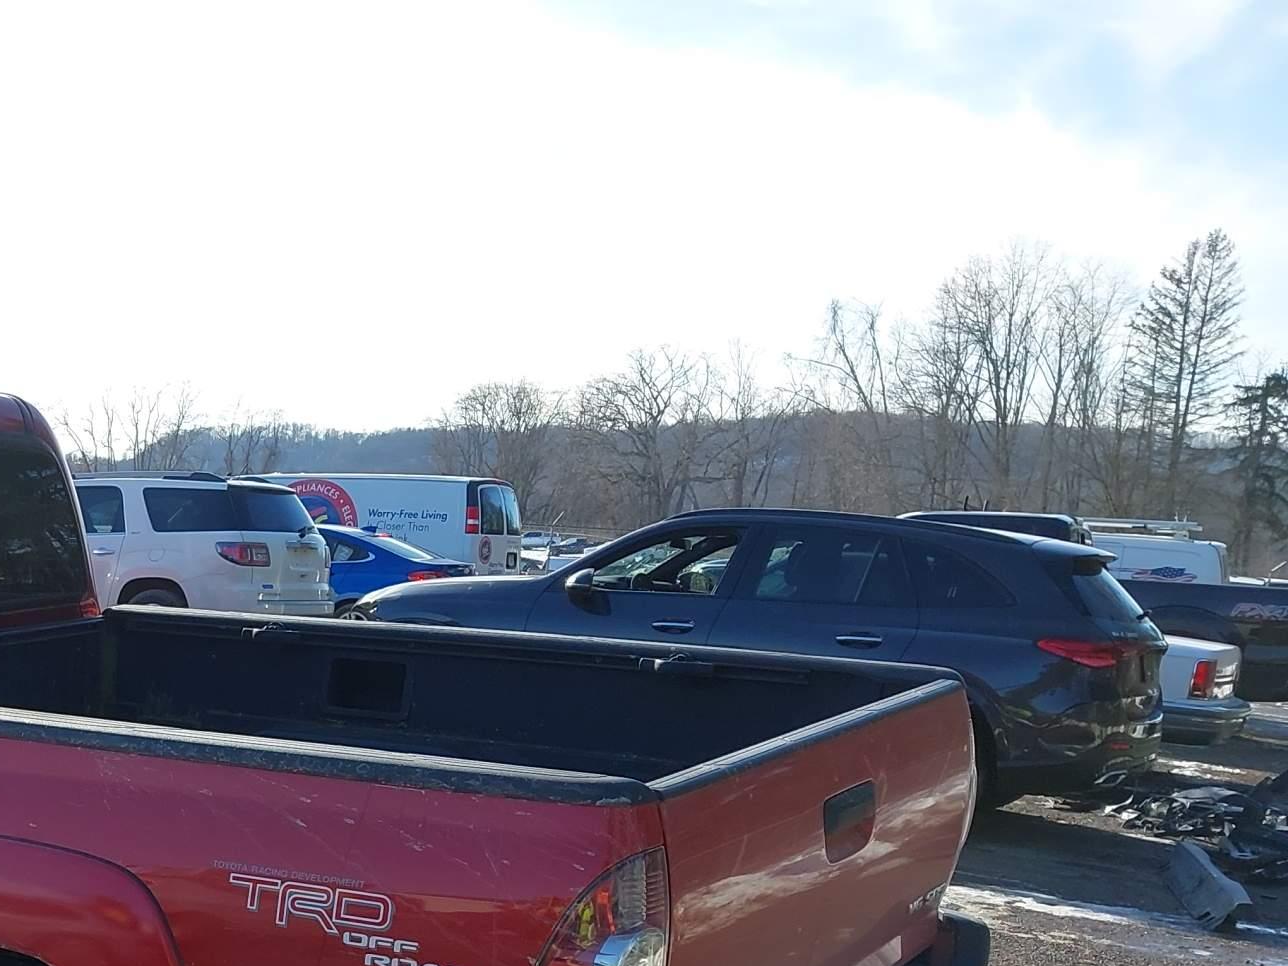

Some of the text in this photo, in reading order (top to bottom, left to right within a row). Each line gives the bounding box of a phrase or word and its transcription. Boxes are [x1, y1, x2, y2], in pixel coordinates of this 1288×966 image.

[368, 509, 447, 522] Worry-Free Living
[376, 521, 404, 531] Closer
[408, 522, 430, 532] Than
[212, 859, 366, 889] TOYOTA RACING DEVELOPMENT
[229, 872, 395, 935] TRD
[342, 931, 419, 953] OFF
